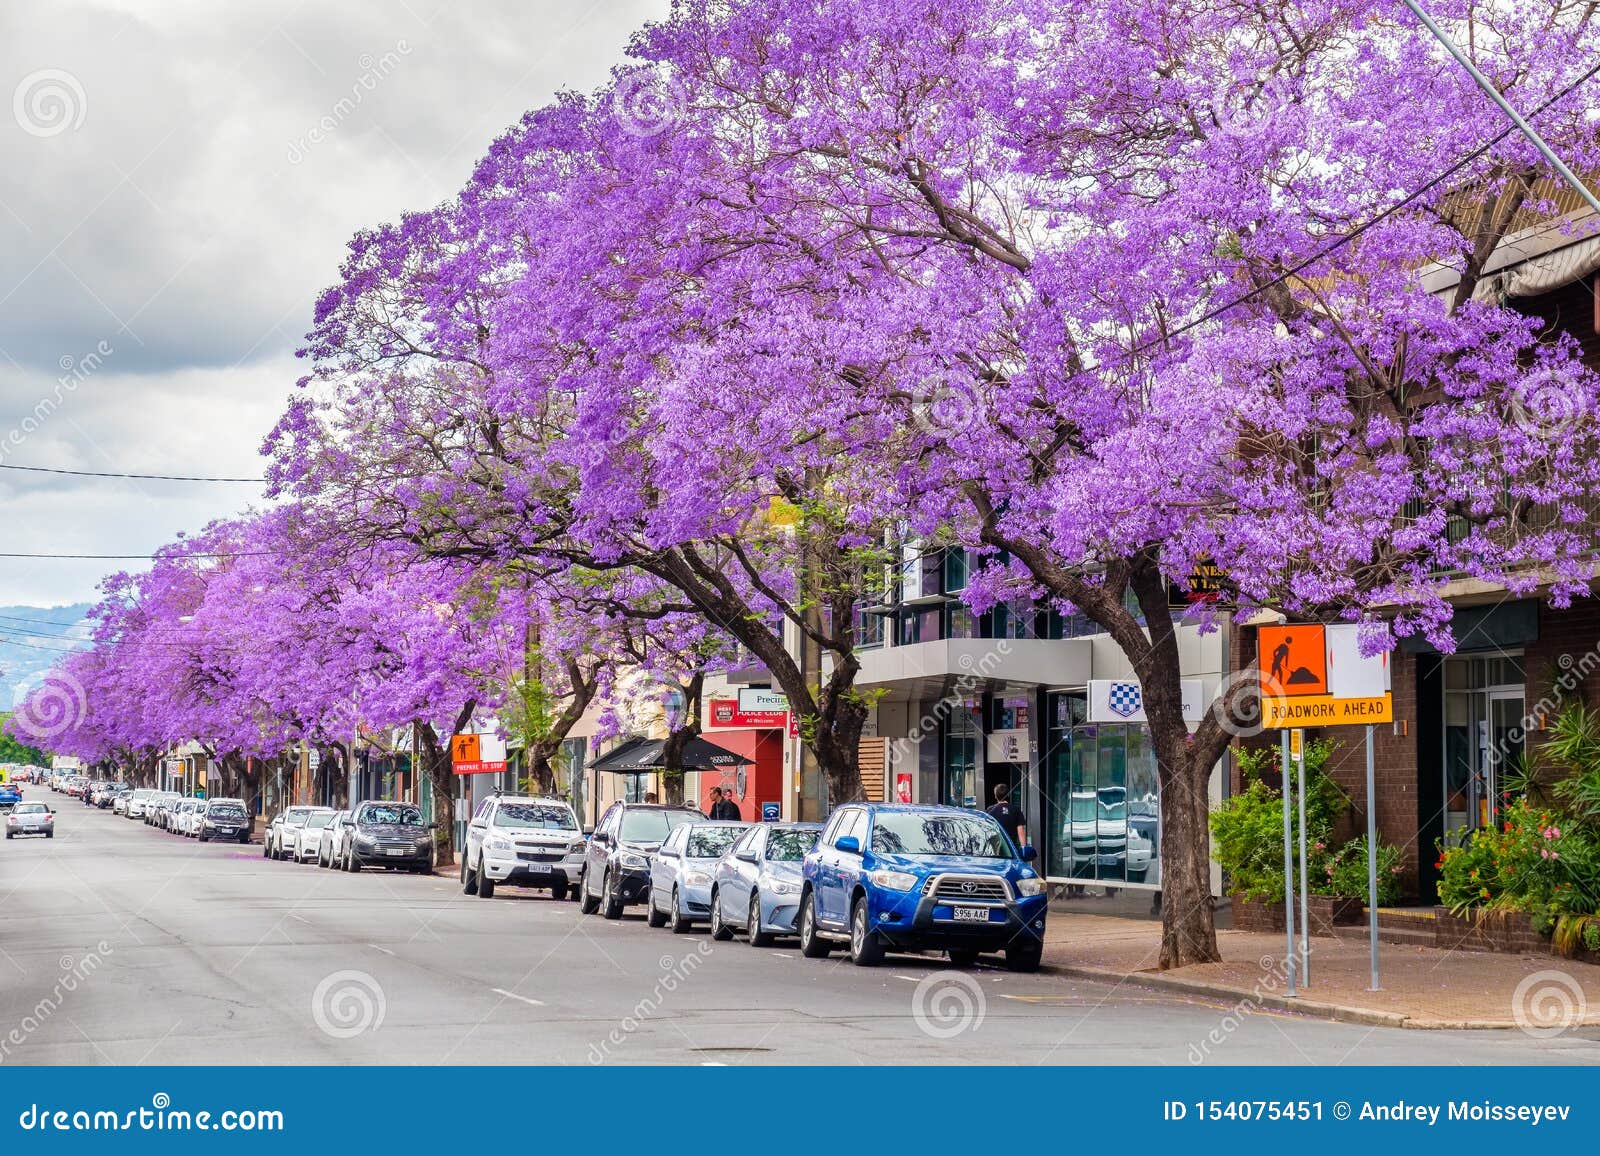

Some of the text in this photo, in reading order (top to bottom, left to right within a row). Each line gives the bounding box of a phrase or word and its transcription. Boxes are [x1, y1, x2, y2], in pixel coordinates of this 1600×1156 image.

[1271, 701, 1384, 719] ROADWORK AHEAD
[456, 763, 478, 771] PREPARE
